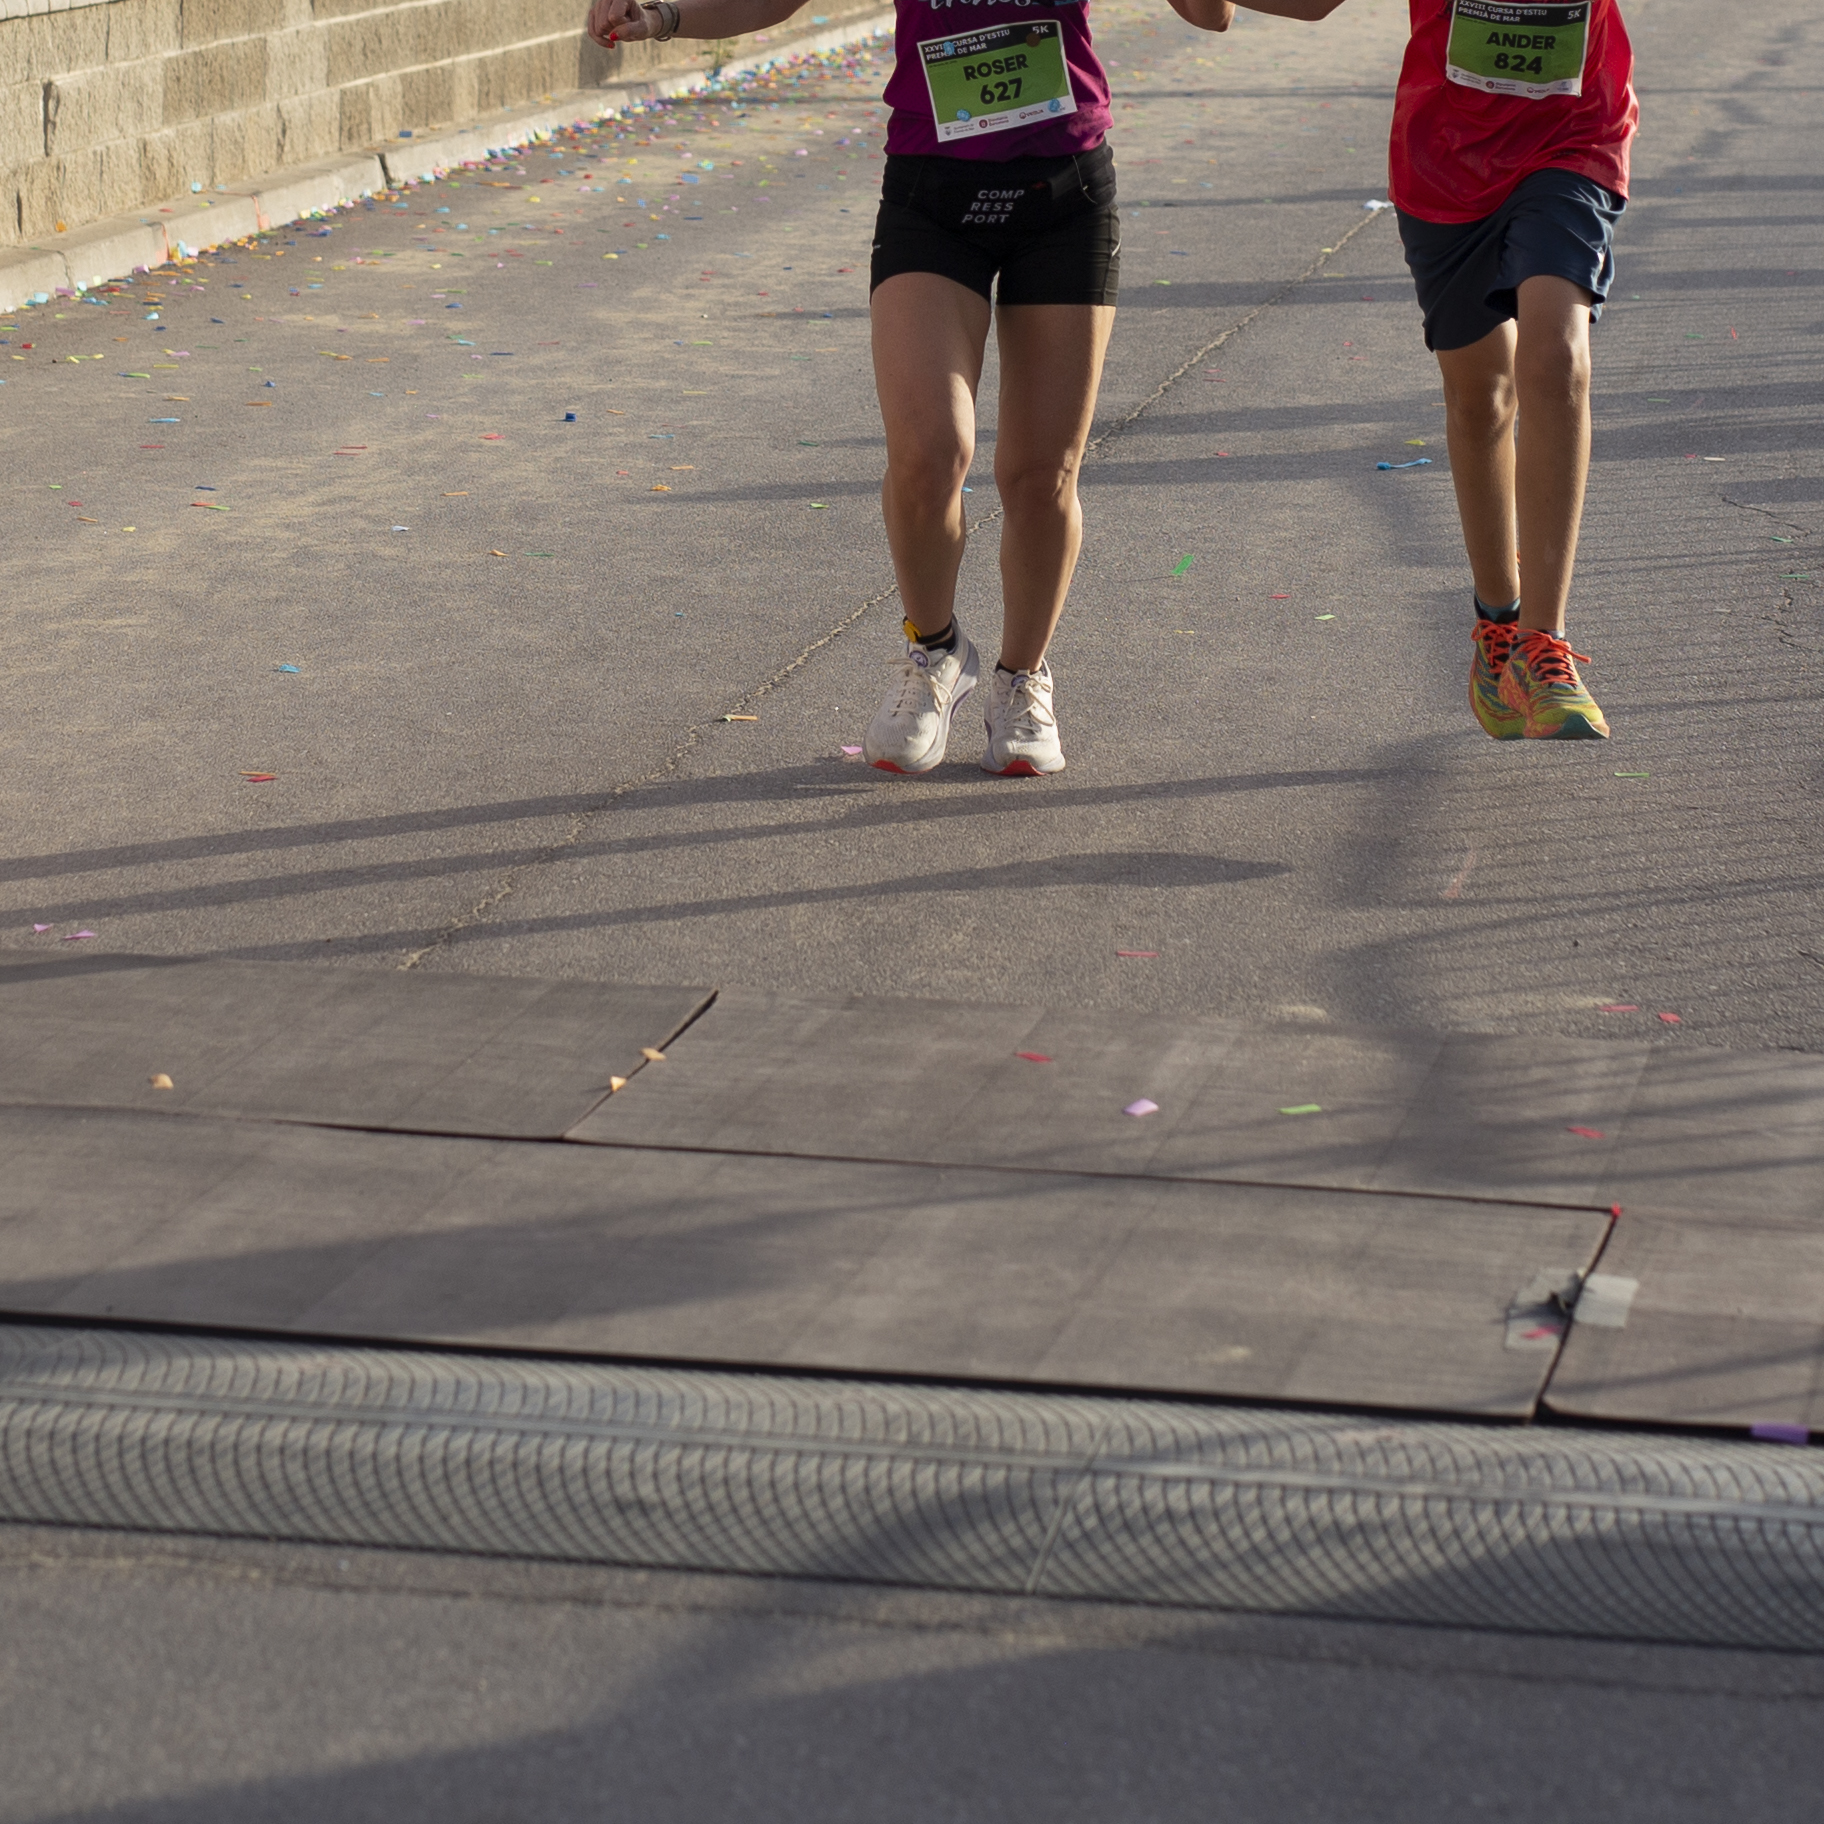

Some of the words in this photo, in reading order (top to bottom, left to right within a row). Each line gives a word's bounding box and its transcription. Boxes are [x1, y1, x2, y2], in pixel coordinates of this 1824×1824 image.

[1458, 6, 1489, 19] PREMIÀ
[1490, 13, 1501, 21] DE
[1502, 15, 1521, 23] MAR
[1487, 5, 1514, 16] CURSA
[1516, 7, 1548, 16] D'ESTIU
[1567, 8, 1582, 20] 5K
[953, 35, 979, 49] CURSA
[979, 28, 1011, 43] D'ESTIU
[1031, 24, 1050, 36] 5K
[1486, 31, 1557, 51] ANDER
[957, 46, 969, 56] DE
[970, 42, 988, 54] MAR
[963, 53, 1030, 81] ROSER
[1493, 52, 1543, 75] 824
[979, 77, 1024, 105] 627
[978, 189, 1025, 199] COMP
[970, 202, 1014, 212] RESS
[961, 214, 1010, 224] PORT
